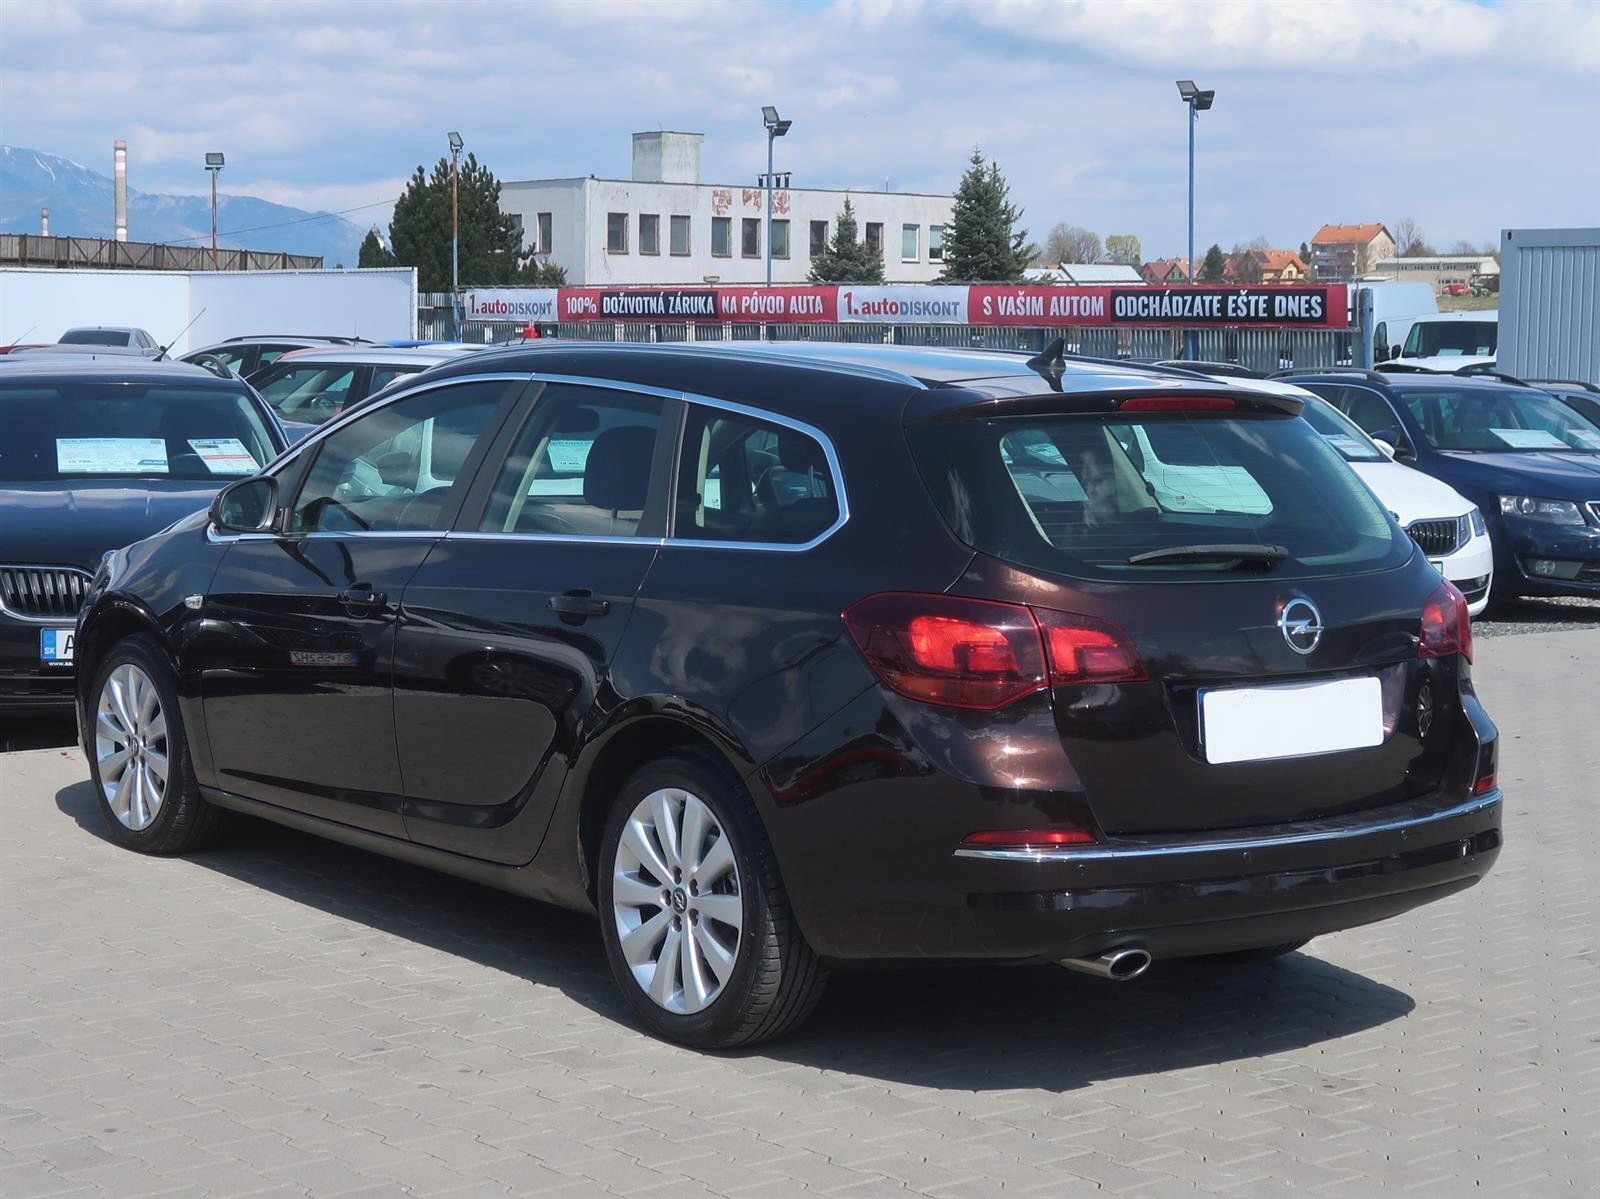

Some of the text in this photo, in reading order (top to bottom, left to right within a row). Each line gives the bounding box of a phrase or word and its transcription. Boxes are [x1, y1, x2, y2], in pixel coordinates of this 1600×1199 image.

[566, 291, 823, 314] 100% DOŽIVOTNÁ ZÁRUKA NA PÔVOD AUTA
[982, 289, 1322, 318] S VAŠIM AUTOM ODCHÁDZATE EŠTE DNES
[44, 647, 55, 655] SK
